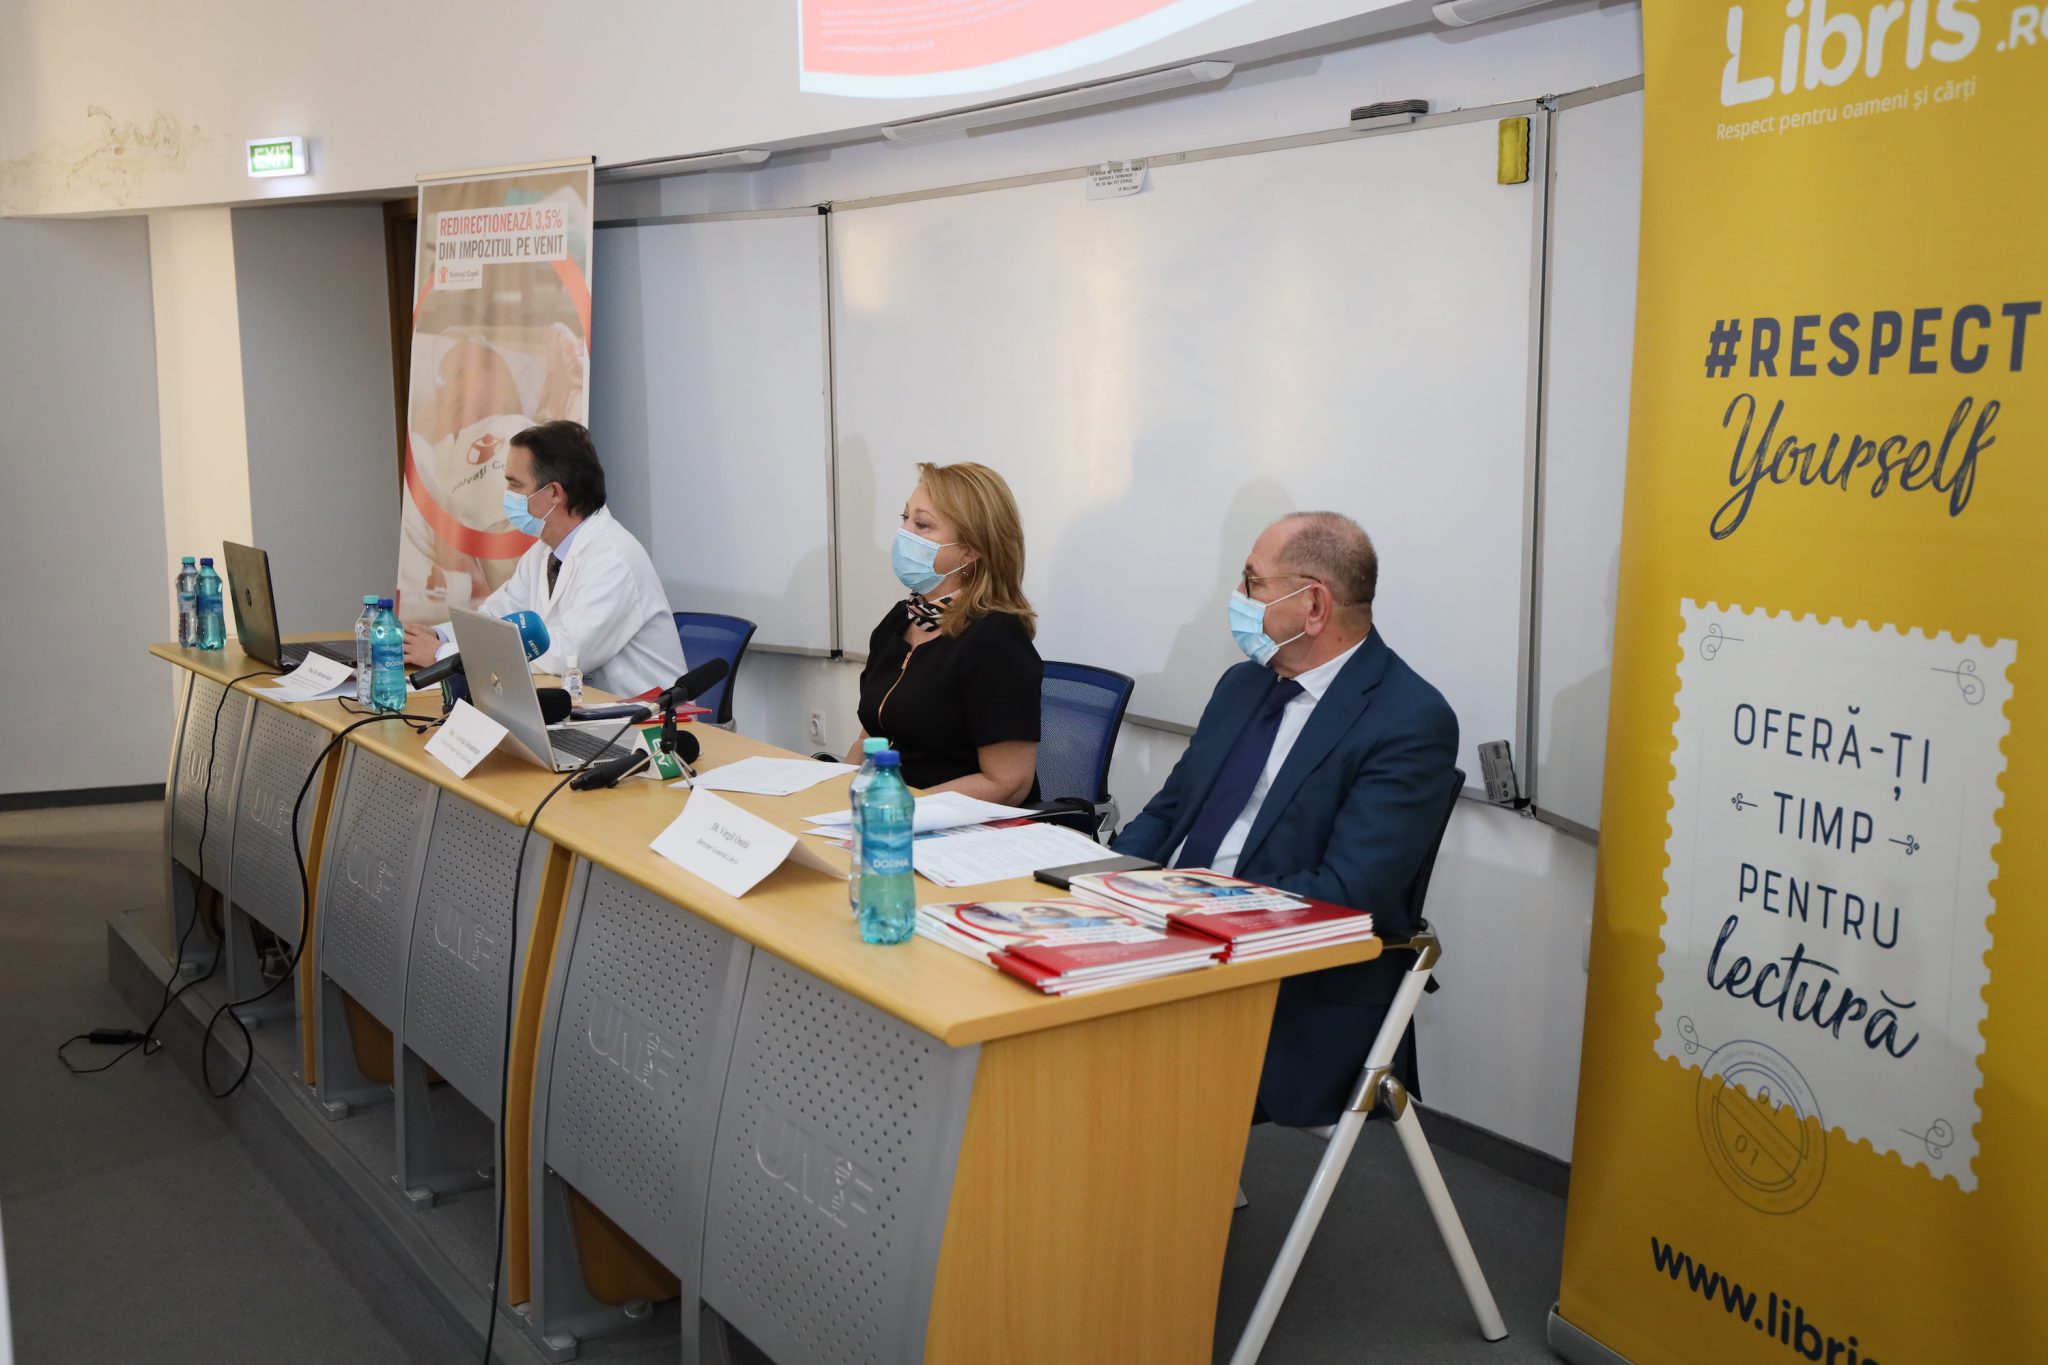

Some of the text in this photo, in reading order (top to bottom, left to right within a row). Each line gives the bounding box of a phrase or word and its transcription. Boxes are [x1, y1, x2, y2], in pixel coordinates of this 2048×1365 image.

[1720, 0, 1981, 107] Libris
[1716, 116, 1775, 141] Respect
[1778, 107, 1838, 135] pentru
[1842, 89, 1909, 120] oameni
[255, 145, 290, 170] EXIT
[439, 234, 564, 261] DIN IMPOZITUL PE VENIT
[535, 208, 563, 231] 3,5%
[1704, 301, 2042, 378] #RESPECT
[1709, 393, 2001, 540] Yourself
[1733, 703, 1930, 801] OFERĂ-ȚI
[1773, 791, 1874, 854] TIMP
[1738, 862, 1900, 949] PENTRU
[1706, 914, 1920, 1059] lectură
[1651, 1236, 1880, 1365] www.libri
